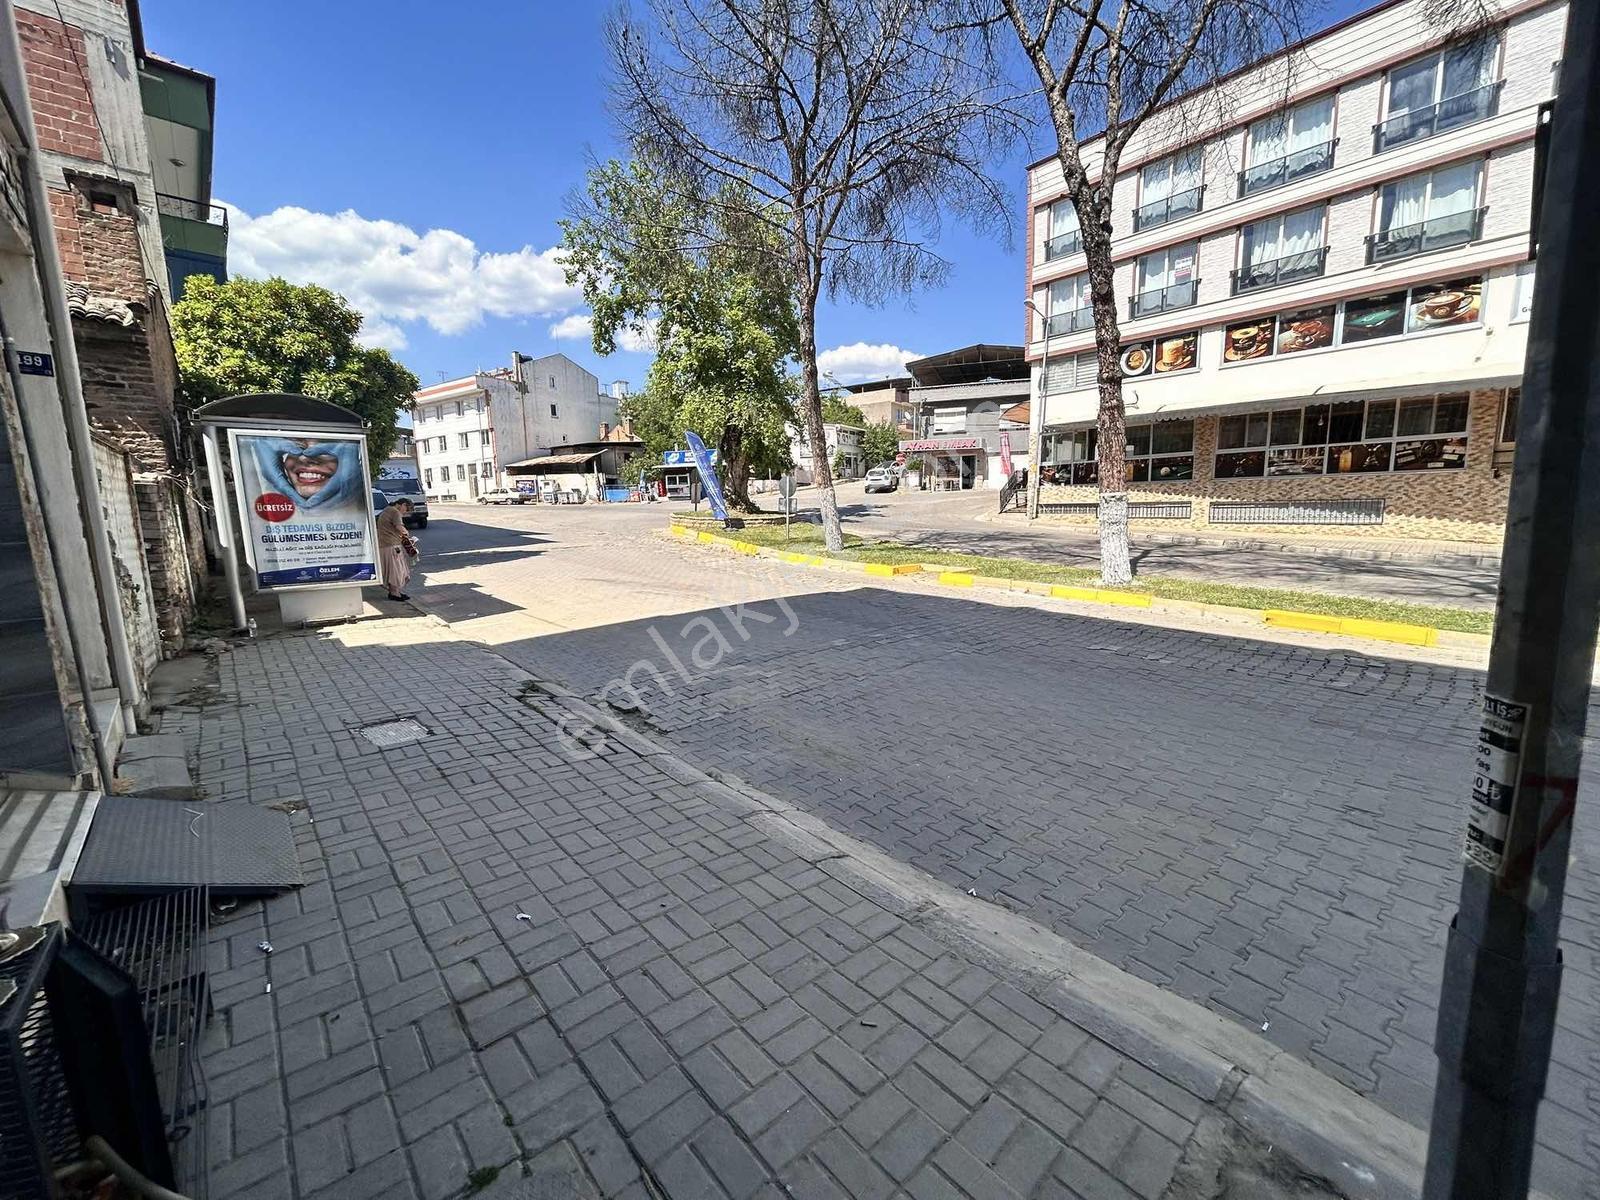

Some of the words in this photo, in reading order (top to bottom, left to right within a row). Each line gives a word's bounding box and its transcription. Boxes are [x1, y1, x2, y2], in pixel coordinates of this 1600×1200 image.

[256, 502, 294, 512] ÜCRETSİZ
[283, 524, 323, 534] TEDAVİSİ
[326, 522, 355, 532] BİZDEN
[330, 531, 363, 541] SİZDEN!
